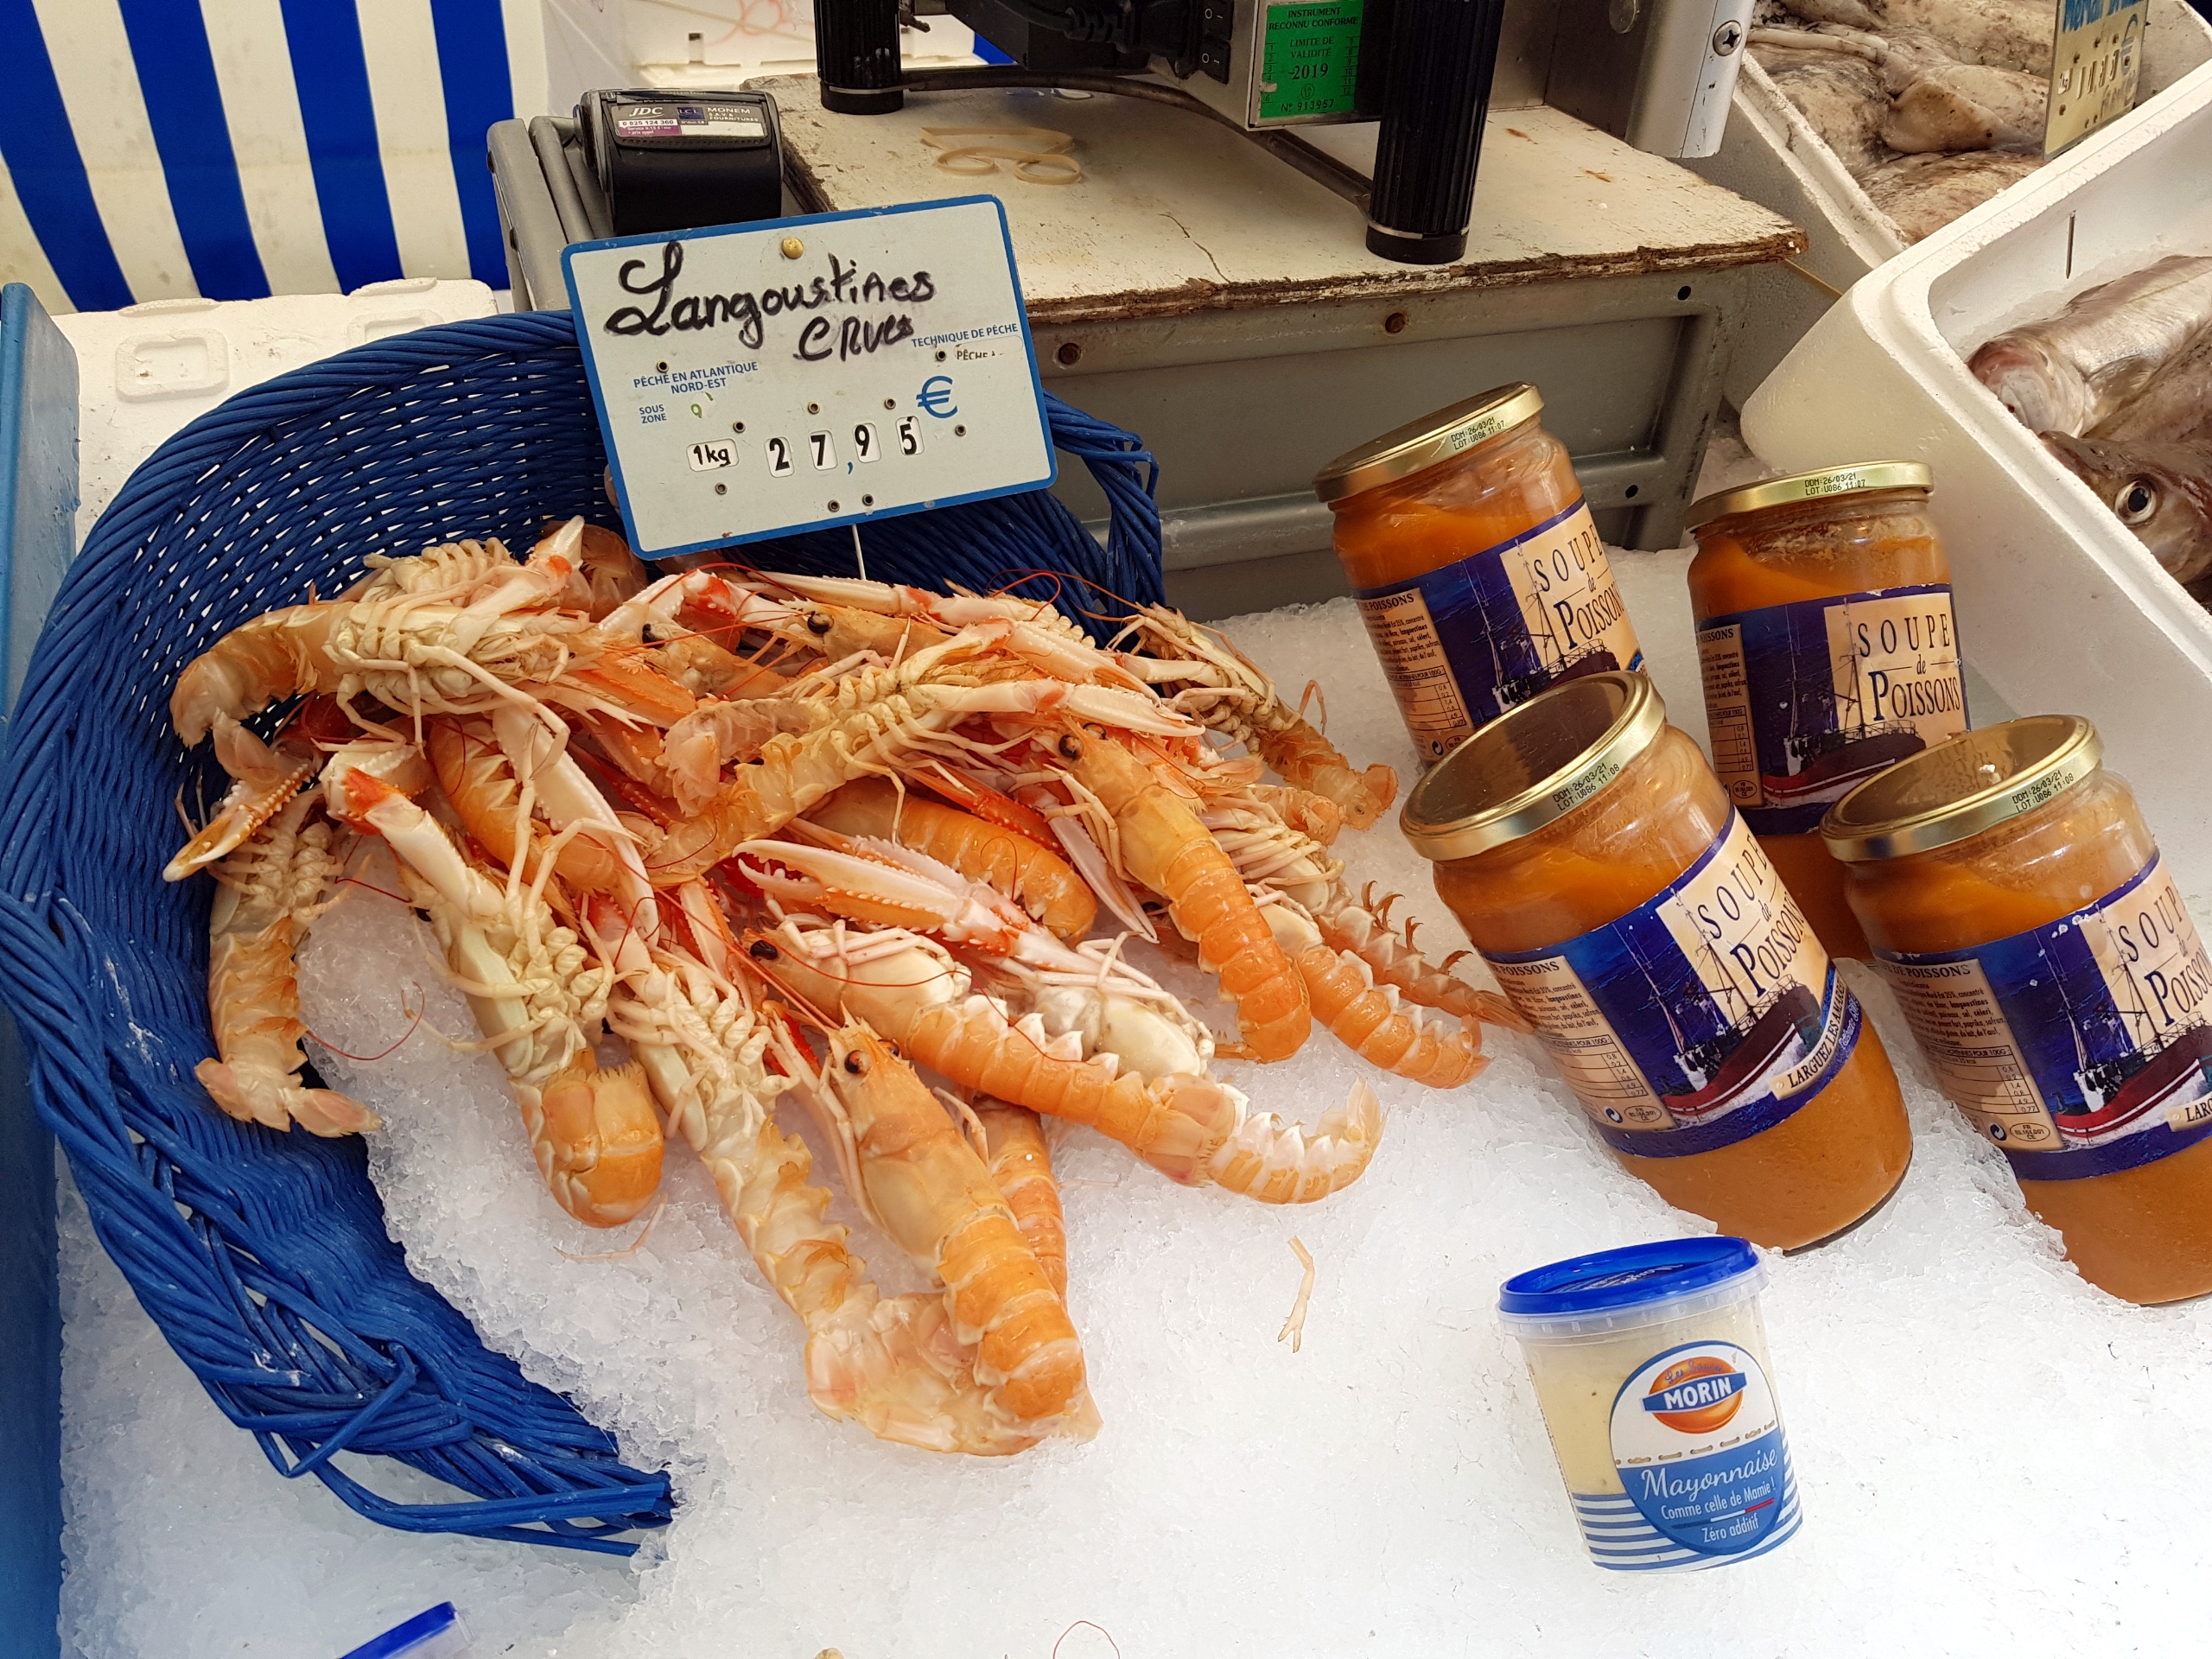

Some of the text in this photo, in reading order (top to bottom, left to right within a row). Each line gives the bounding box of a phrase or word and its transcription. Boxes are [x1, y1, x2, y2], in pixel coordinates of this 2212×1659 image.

[1287, 7, 1342, 18] INSTRUMENT
[1268, 17, 1358, 30] RECONNU CONFORME
[1290, 36, 1334, 48] LIMITE DE
[1292, 62, 1329, 79] 2019
[629, 106, 663, 117] JDC
[1297, 99, 1335, 111] 913957
[604, 240, 936, 349] Langoustines
[912, 323, 1018, 347] TECHNIQUE DE PÊCHE
[672, 372, 687, 382] EN
[690, 361, 759, 380] ATLANTIQUE
[671, 378, 727, 394] NORD-EST
[639, 404, 664, 415] SOUS
[641, 413, 667, 423] ZONE
[693, 445, 731, 467] 1kg
[1533, 524, 1603, 592] SOUPE
[1587, 572, 1597, 593] de
[1858, 613, 1950, 658] SOUPE
[1916, 654, 1926, 675] de
[1868, 671, 1961, 721] POISSONS
[1697, 833, 1768, 939] SOUPE
[1758, 899, 1771, 922] de
[2118, 885, 2184, 963] SOUP
[1500, 961, 1560, 976] POISSONS
[1905, 963, 1971, 978] POISSONS
[1788, 1039, 1832, 1089] LARGUEZ
[1826, 1020, 1840, 1046] LES
[1664, 1369, 1684, 1384] Les
[1663, 1376, 1732, 1410] MORIN
[1642, 1448, 1778, 1503] Mayonnaise
[1661, 1503, 1702, 1520] Comme
[1705, 1494, 1728, 1513] celle
[1730, 1490, 1742, 1507] de
[1744, 1481, 1770, 1503] Mamie
[1700, 1513, 1759, 1543] Zéro additif
